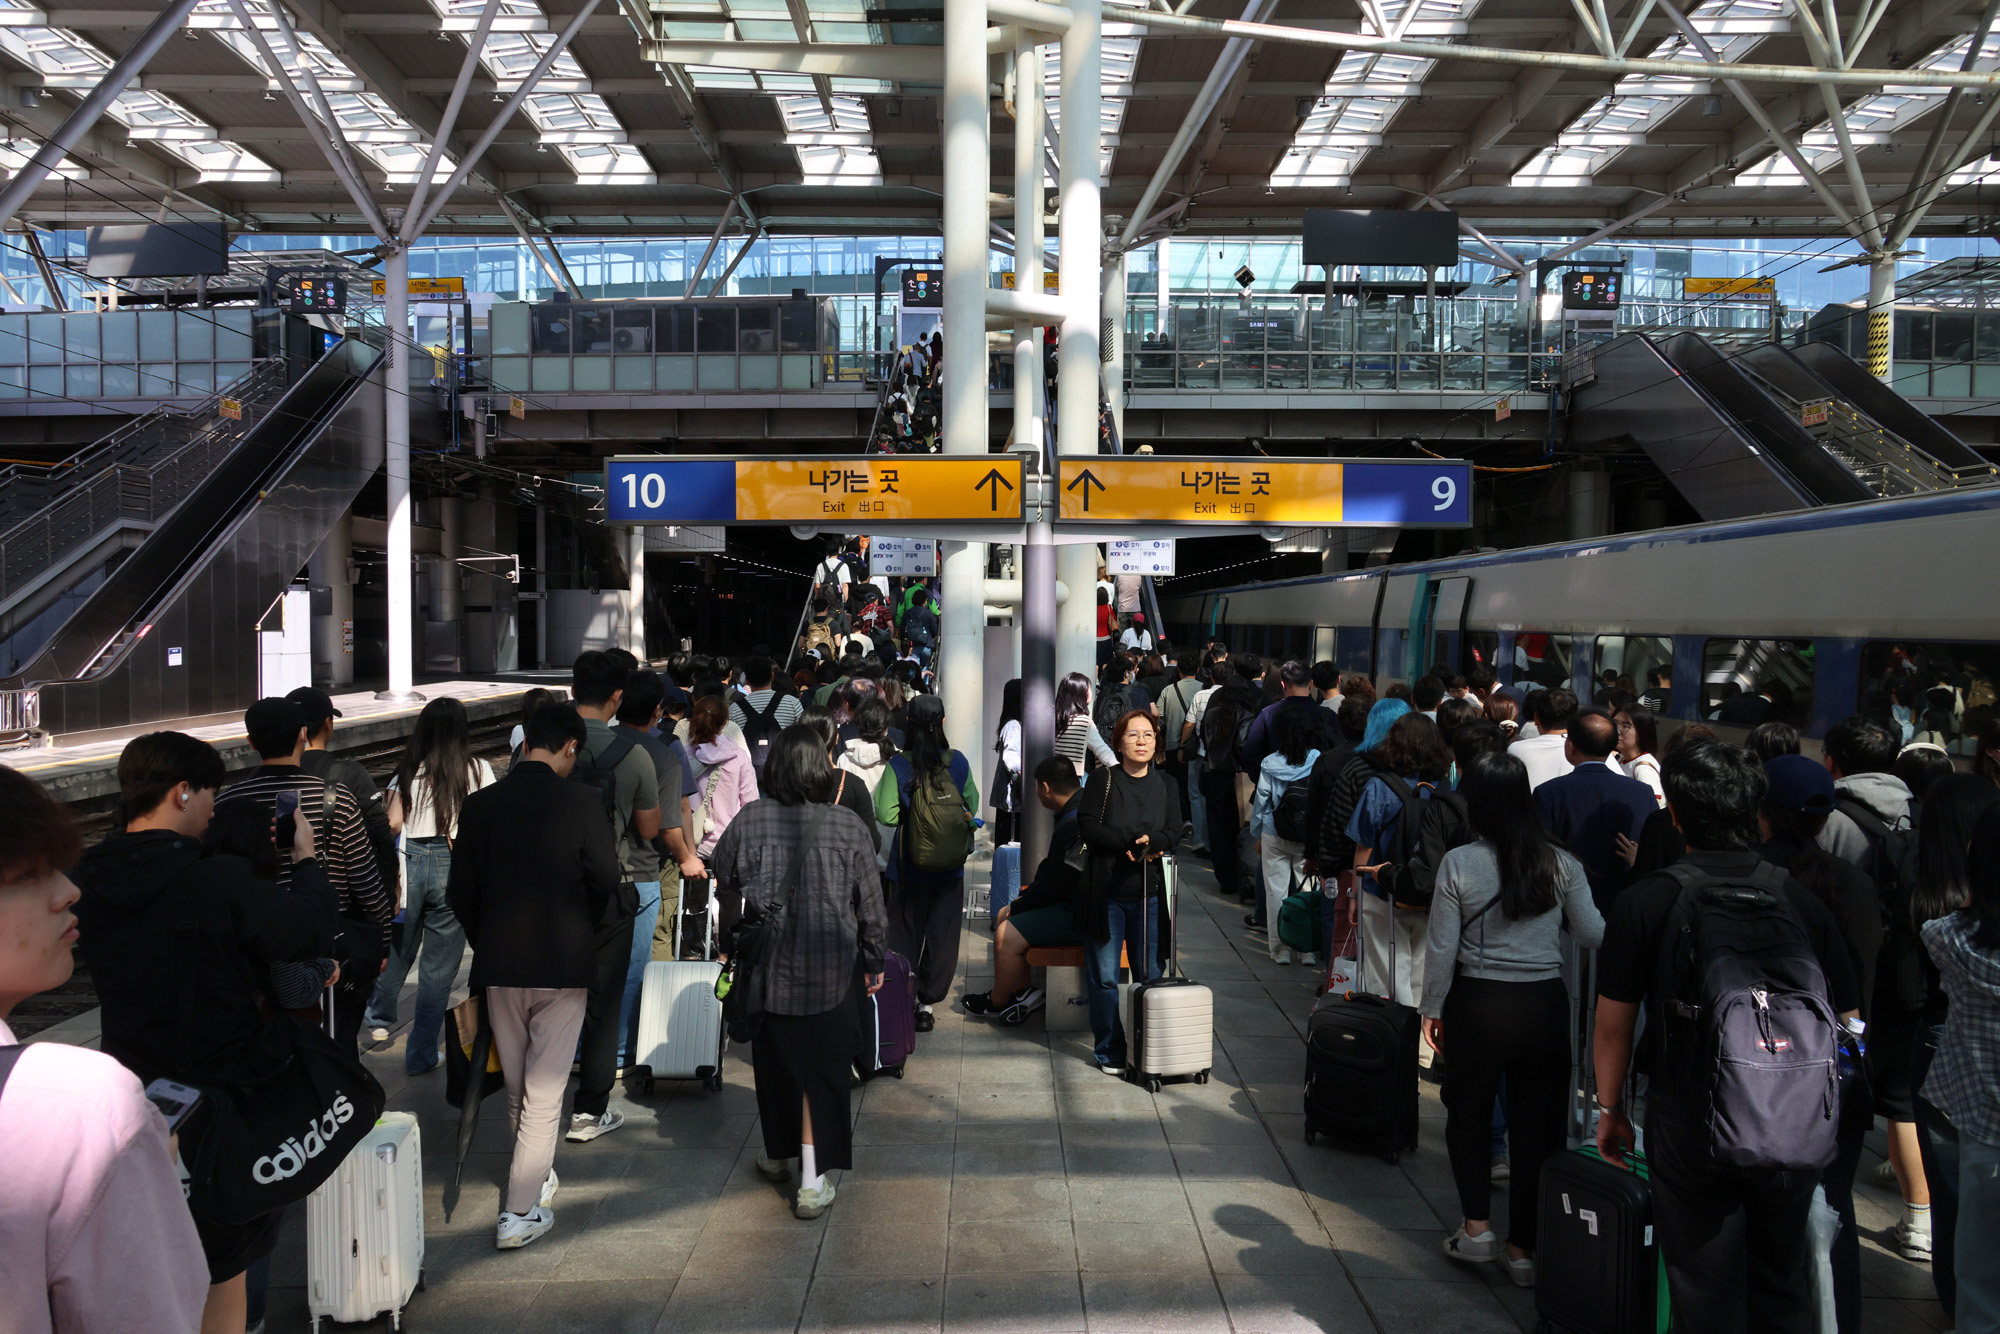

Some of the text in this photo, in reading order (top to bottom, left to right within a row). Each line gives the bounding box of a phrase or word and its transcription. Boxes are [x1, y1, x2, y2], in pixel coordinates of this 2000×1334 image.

[621, 473, 666, 508] 10
[809, 469, 900, 493] 나가는 곳
[1181, 471, 1271, 495] 나가는 곳
[1431, 476, 1456, 511] 9
[823, 501, 884, 513] Exit 出口
[1194, 501, 1255, 514] Exit 出口
[252, 1095, 354, 1185] adidas
